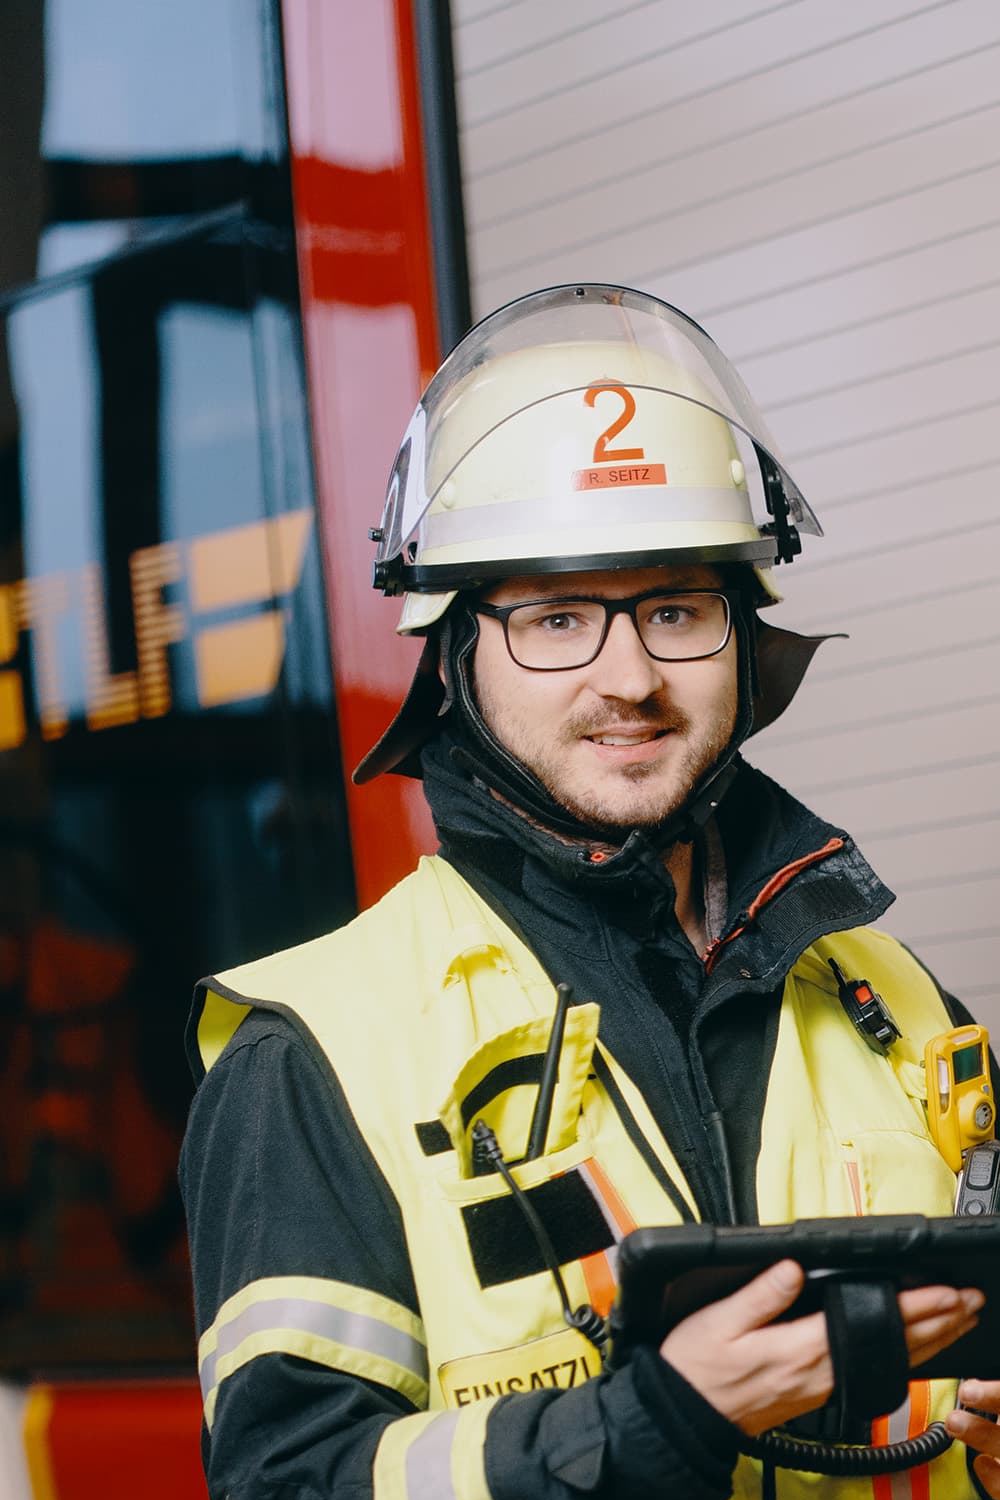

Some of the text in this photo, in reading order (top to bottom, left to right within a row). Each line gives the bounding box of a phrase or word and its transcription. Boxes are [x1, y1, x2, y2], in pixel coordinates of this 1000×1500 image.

[583, 378, 645, 464] 2
[588, 468, 651, 485] R. SEITZ
